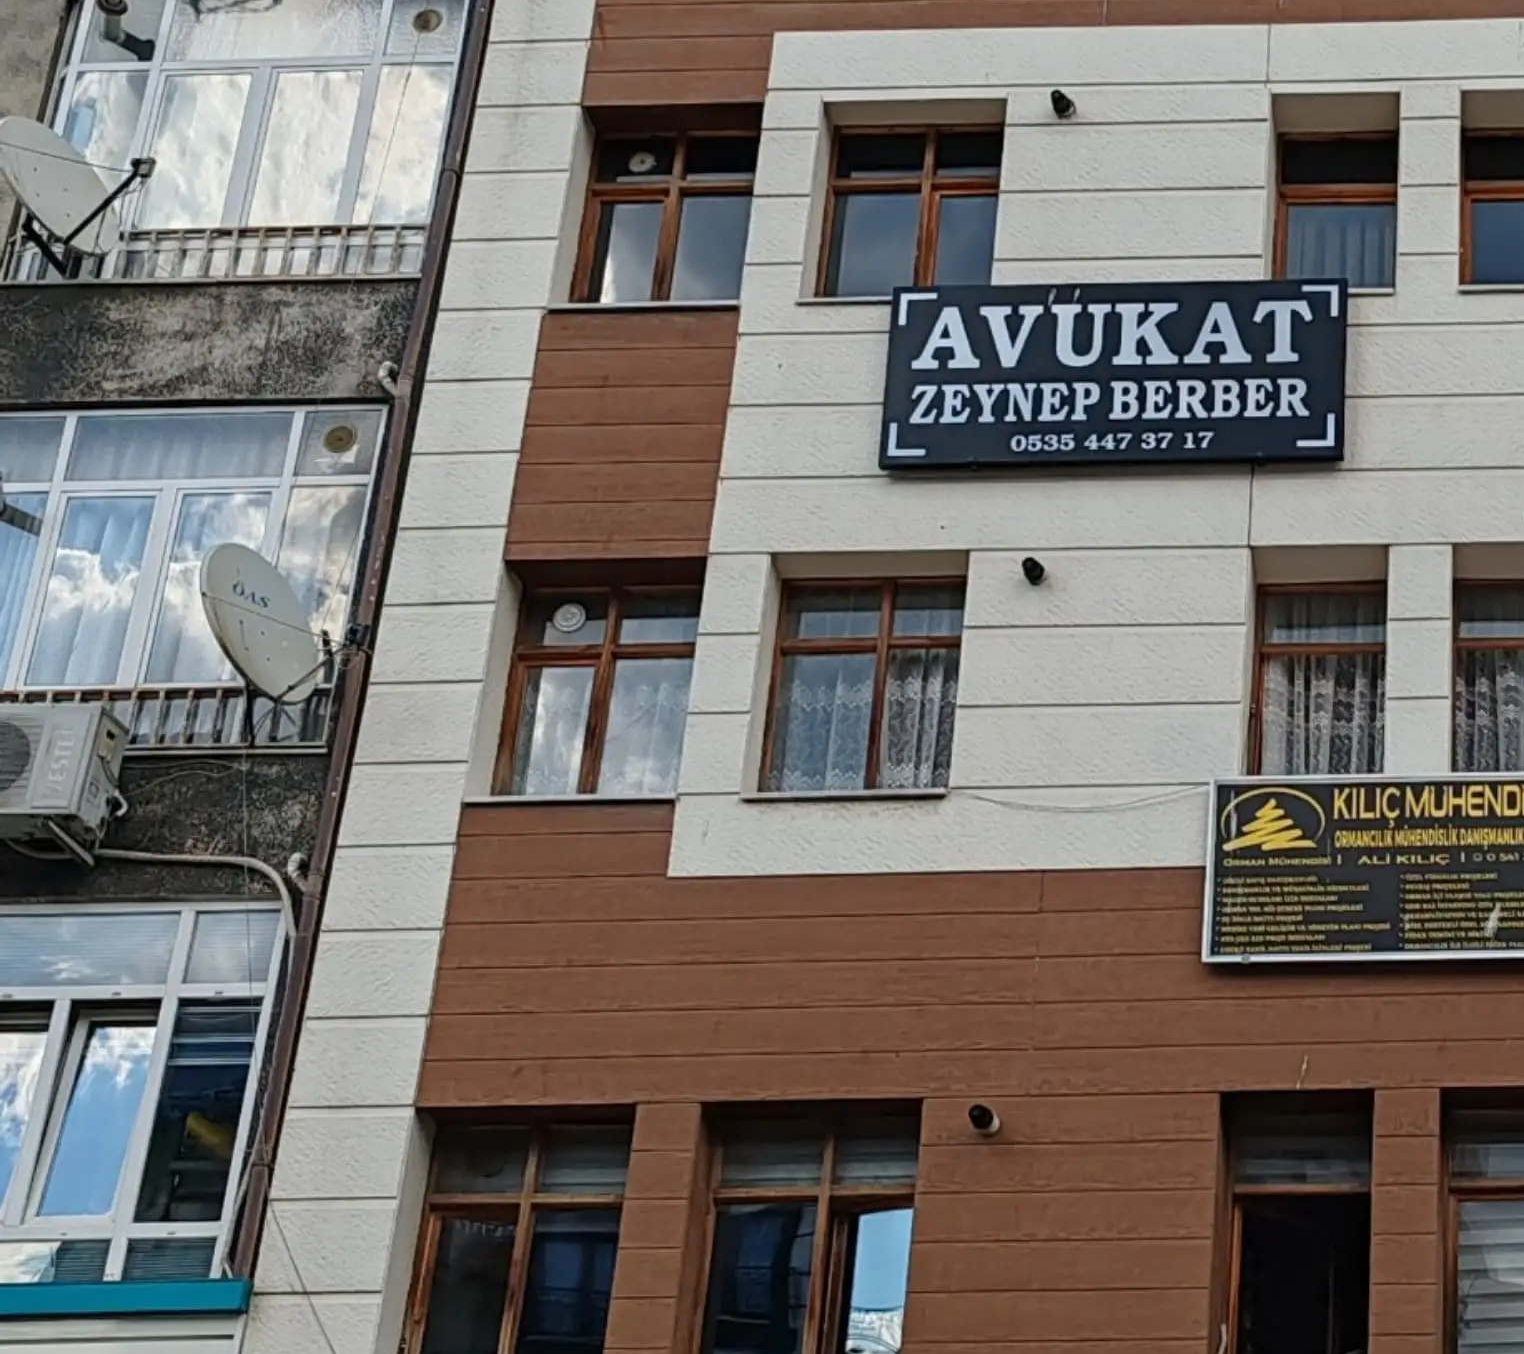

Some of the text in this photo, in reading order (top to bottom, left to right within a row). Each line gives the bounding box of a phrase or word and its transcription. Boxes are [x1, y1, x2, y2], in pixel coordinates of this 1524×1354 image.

[909, 378, 1310, 425] ZEYNEP BERBER
[1010, 432, 1214, 452] 0535 447 37 17
[1333, 787, 1400, 827] KILIÇ
[1334, 829, 1393, 848] ORMANCILIK
[1357, 854, 1390, 866] ALİ
[1396, 852, 1450, 865] KILIÇ
